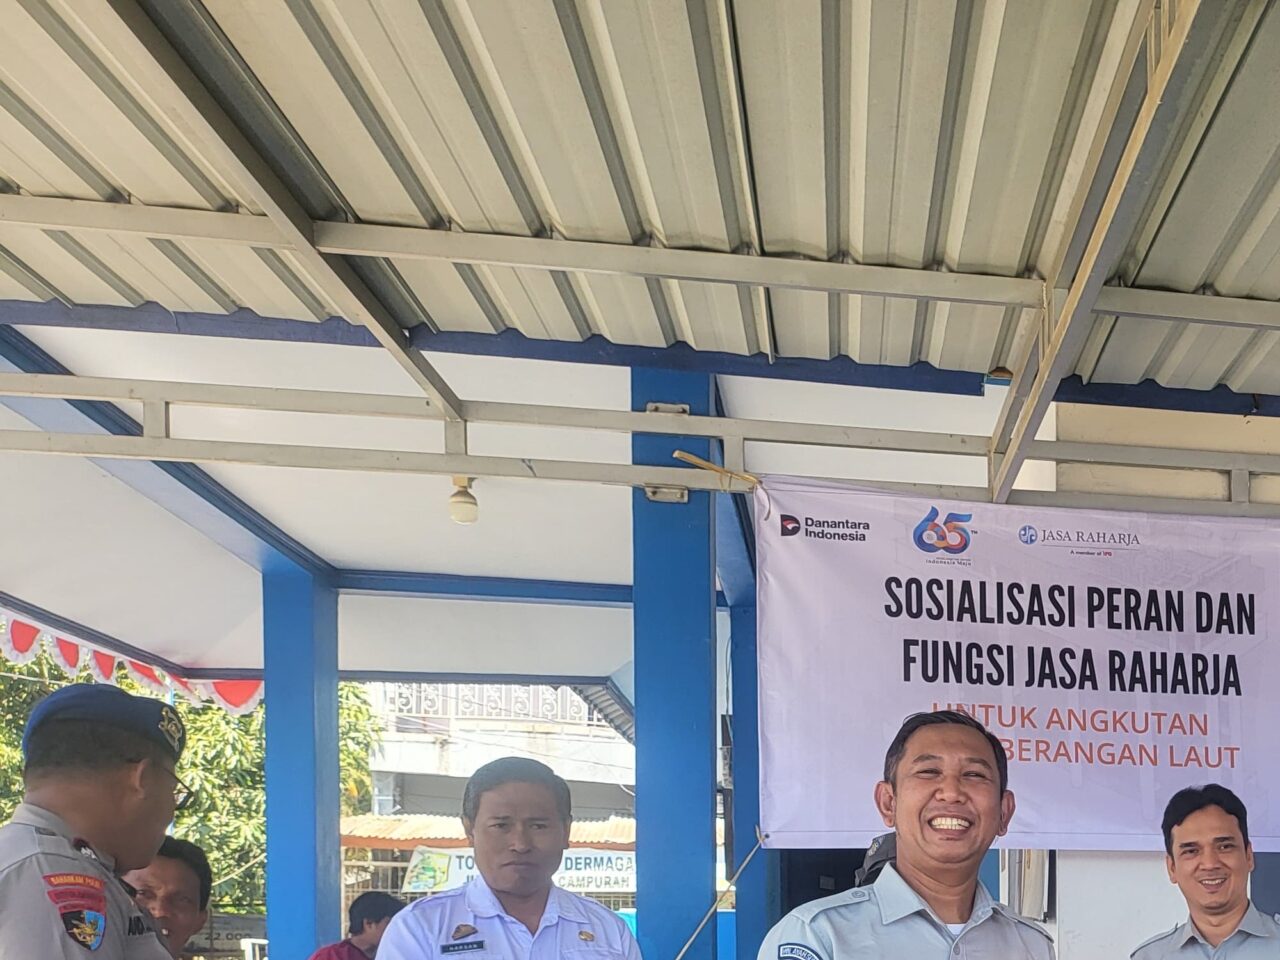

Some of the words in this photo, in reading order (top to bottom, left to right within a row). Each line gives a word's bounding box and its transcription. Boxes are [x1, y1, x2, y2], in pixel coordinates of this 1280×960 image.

[804, 516, 870, 531] Danantara
[804, 528, 866, 542] Indonesia
[1040, 528, 1072, 543] JASA
[1076, 529, 1141, 546] RAHARJA
[884, 576, 1075, 627] SOSIALISASI
[1087, 587, 1184, 633] PERAN
[1196, 591, 1256, 635] DAN
[903, 638, 1015, 687] FUNGSI
[1024, 646, 1099, 691] JASA
[1108, 650, 1242, 697] RAHARJA
[1046, 708, 1209, 736] ANGKUTAN
[1000, 738, 1159, 767] BERANGAN
[1168, 746, 1240, 769] LAUT
[456, 855, 475, 870] TO
[564, 856, 634, 871] DERMAGA
